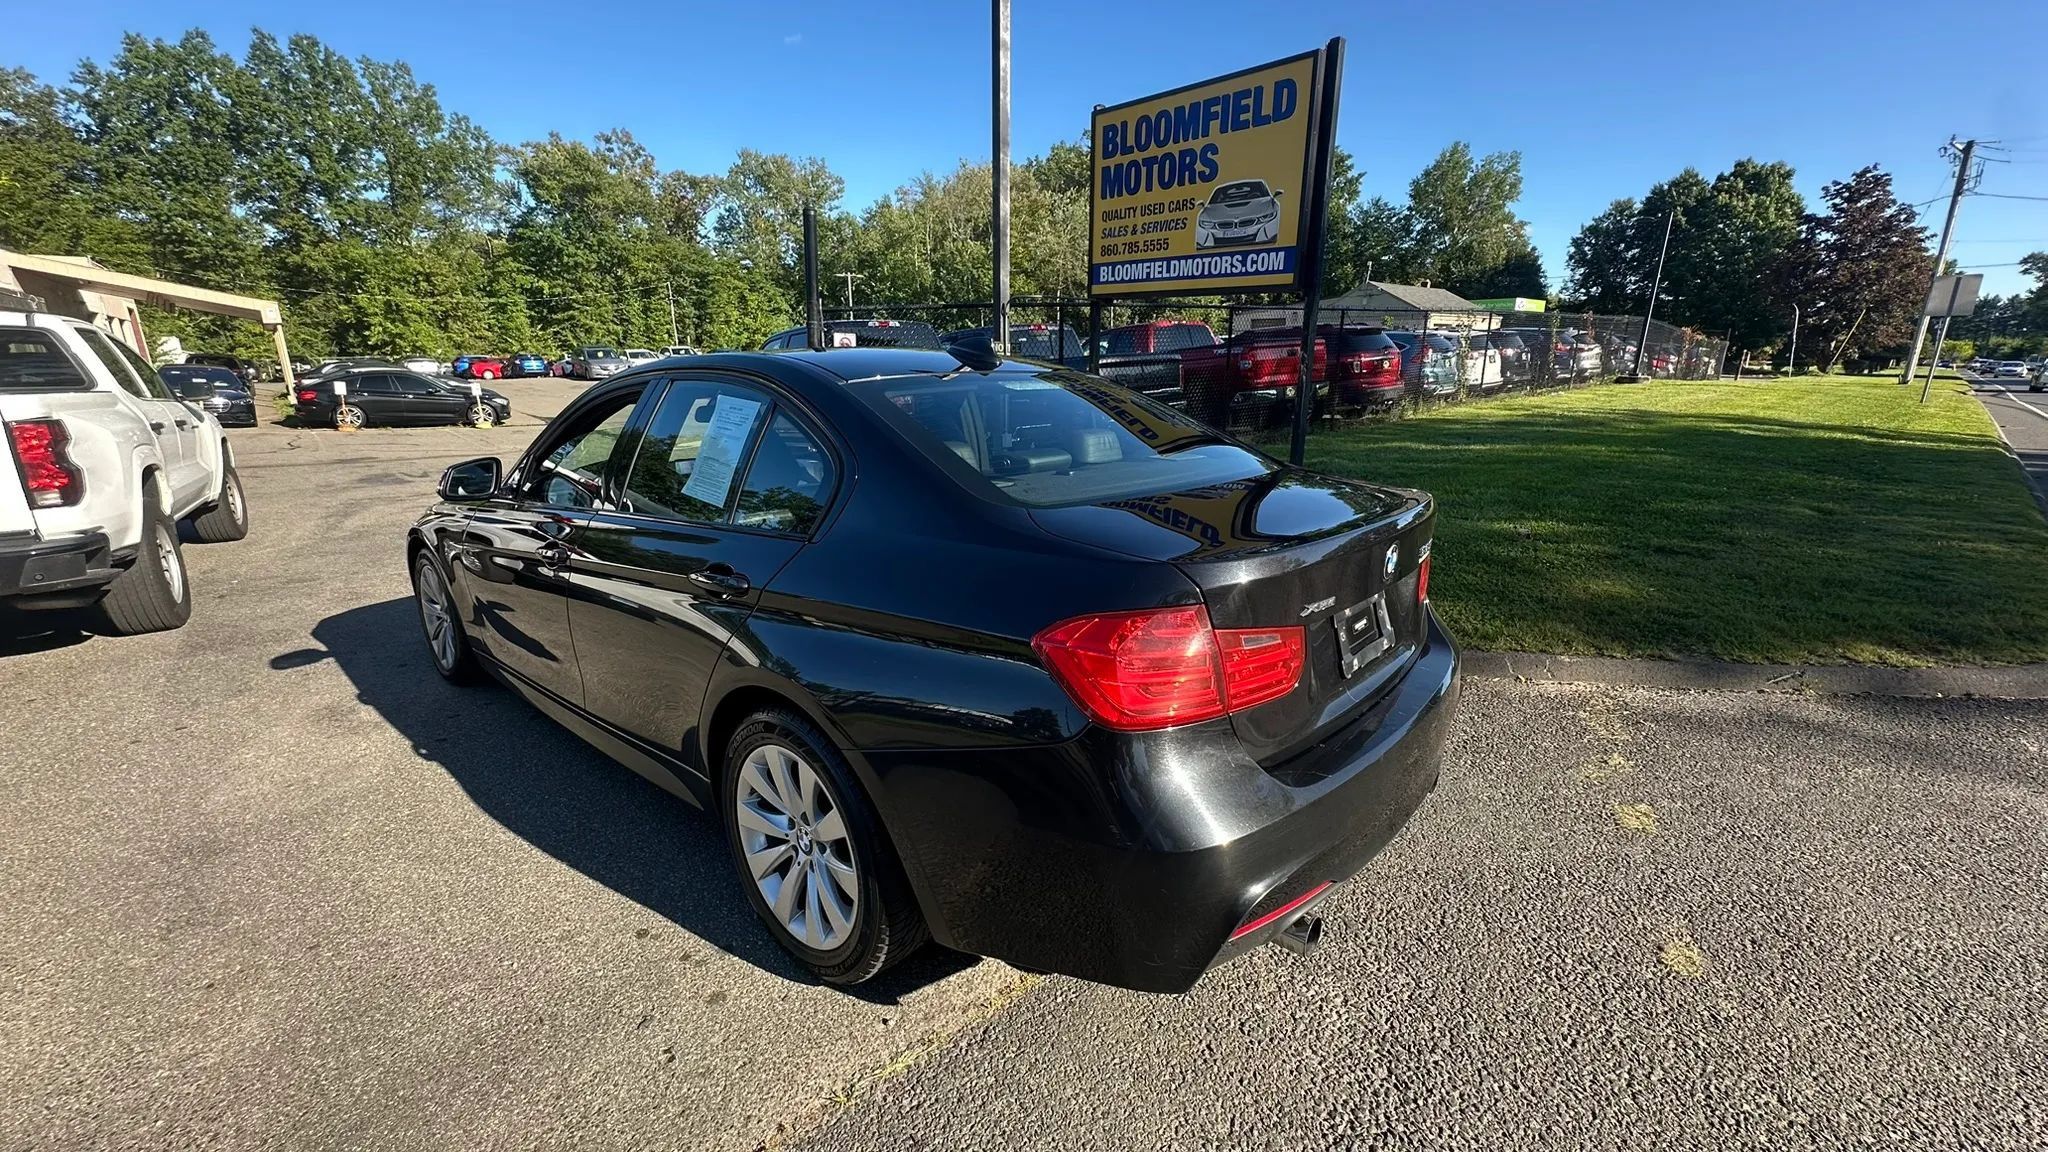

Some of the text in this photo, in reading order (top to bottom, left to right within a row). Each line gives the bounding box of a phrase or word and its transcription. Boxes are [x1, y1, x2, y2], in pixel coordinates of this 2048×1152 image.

[1102, 78, 1297, 160] BLOOMFIELD
[1101, 143, 1219, 200] MOTORS
[1102, 198, 1195, 223] QUALITY USED CARS
[1101, 217, 1188, 239] SALES & SERVICES
[1100, 238, 1169, 257] 860.785.5555
[1099, 251, 1285, 282] BLOOMFIELDMOTORS.COM
